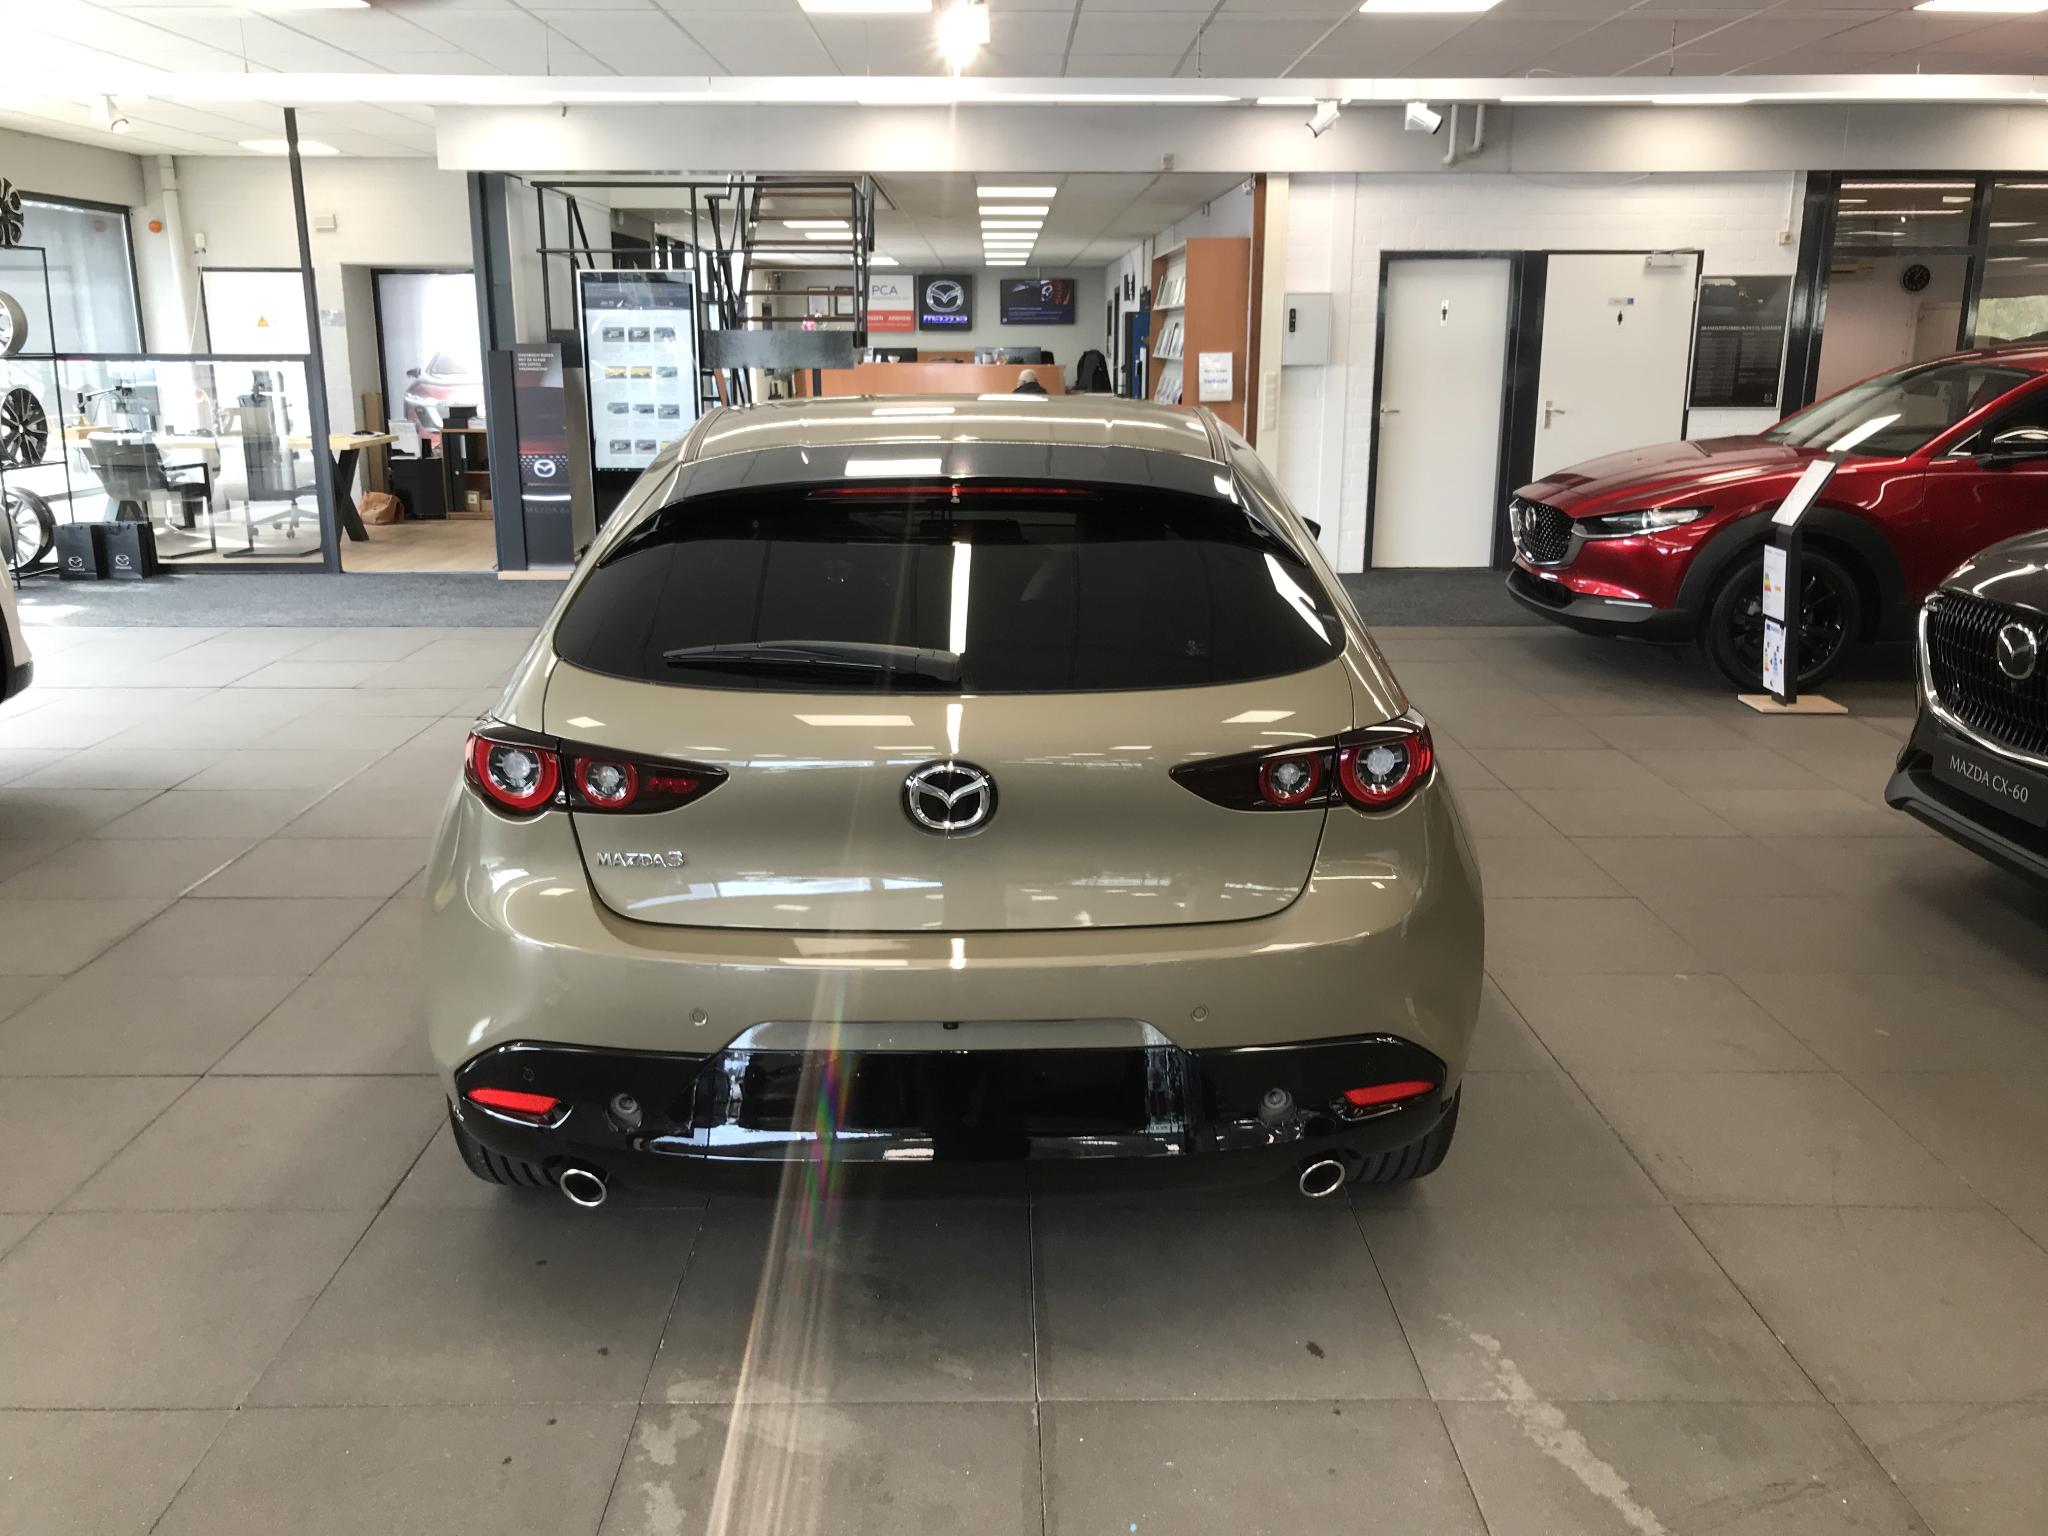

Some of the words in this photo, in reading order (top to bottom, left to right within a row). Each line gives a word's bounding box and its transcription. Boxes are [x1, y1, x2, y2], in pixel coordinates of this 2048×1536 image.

[1949, 754, 1989, 787] MAZDA
[1992, 775, 2029, 803] CX-60
[597, 850, 685, 869] MAZDA3
